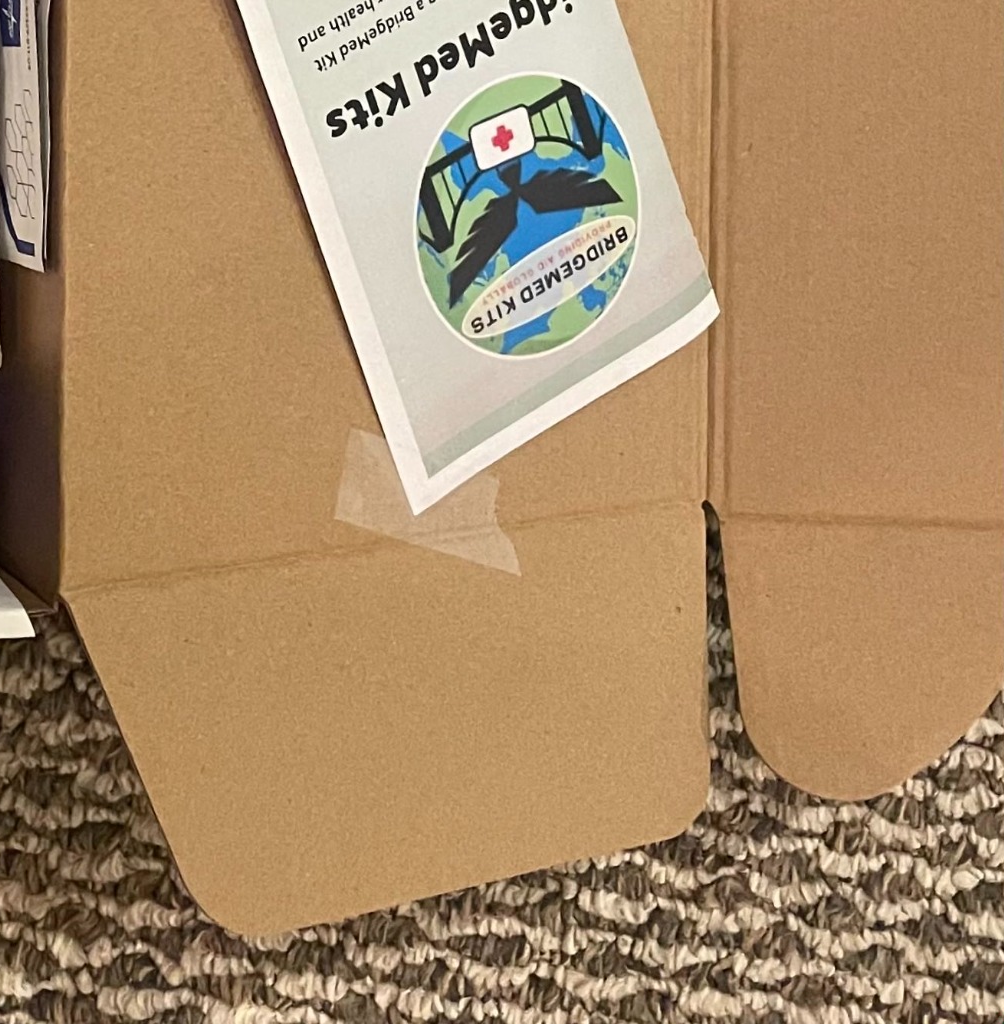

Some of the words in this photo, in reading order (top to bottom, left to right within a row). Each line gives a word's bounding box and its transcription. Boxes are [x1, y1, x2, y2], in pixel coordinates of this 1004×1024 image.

[297, 25, 327, 53] and
[338, 5, 416, 62] BridgeMed
[313, 50, 338, 73] Kit
[325, 71, 412, 139] Kits
[519, 225, 629, 304] BRIDGEMED
[470, 295, 517, 334] KITS
